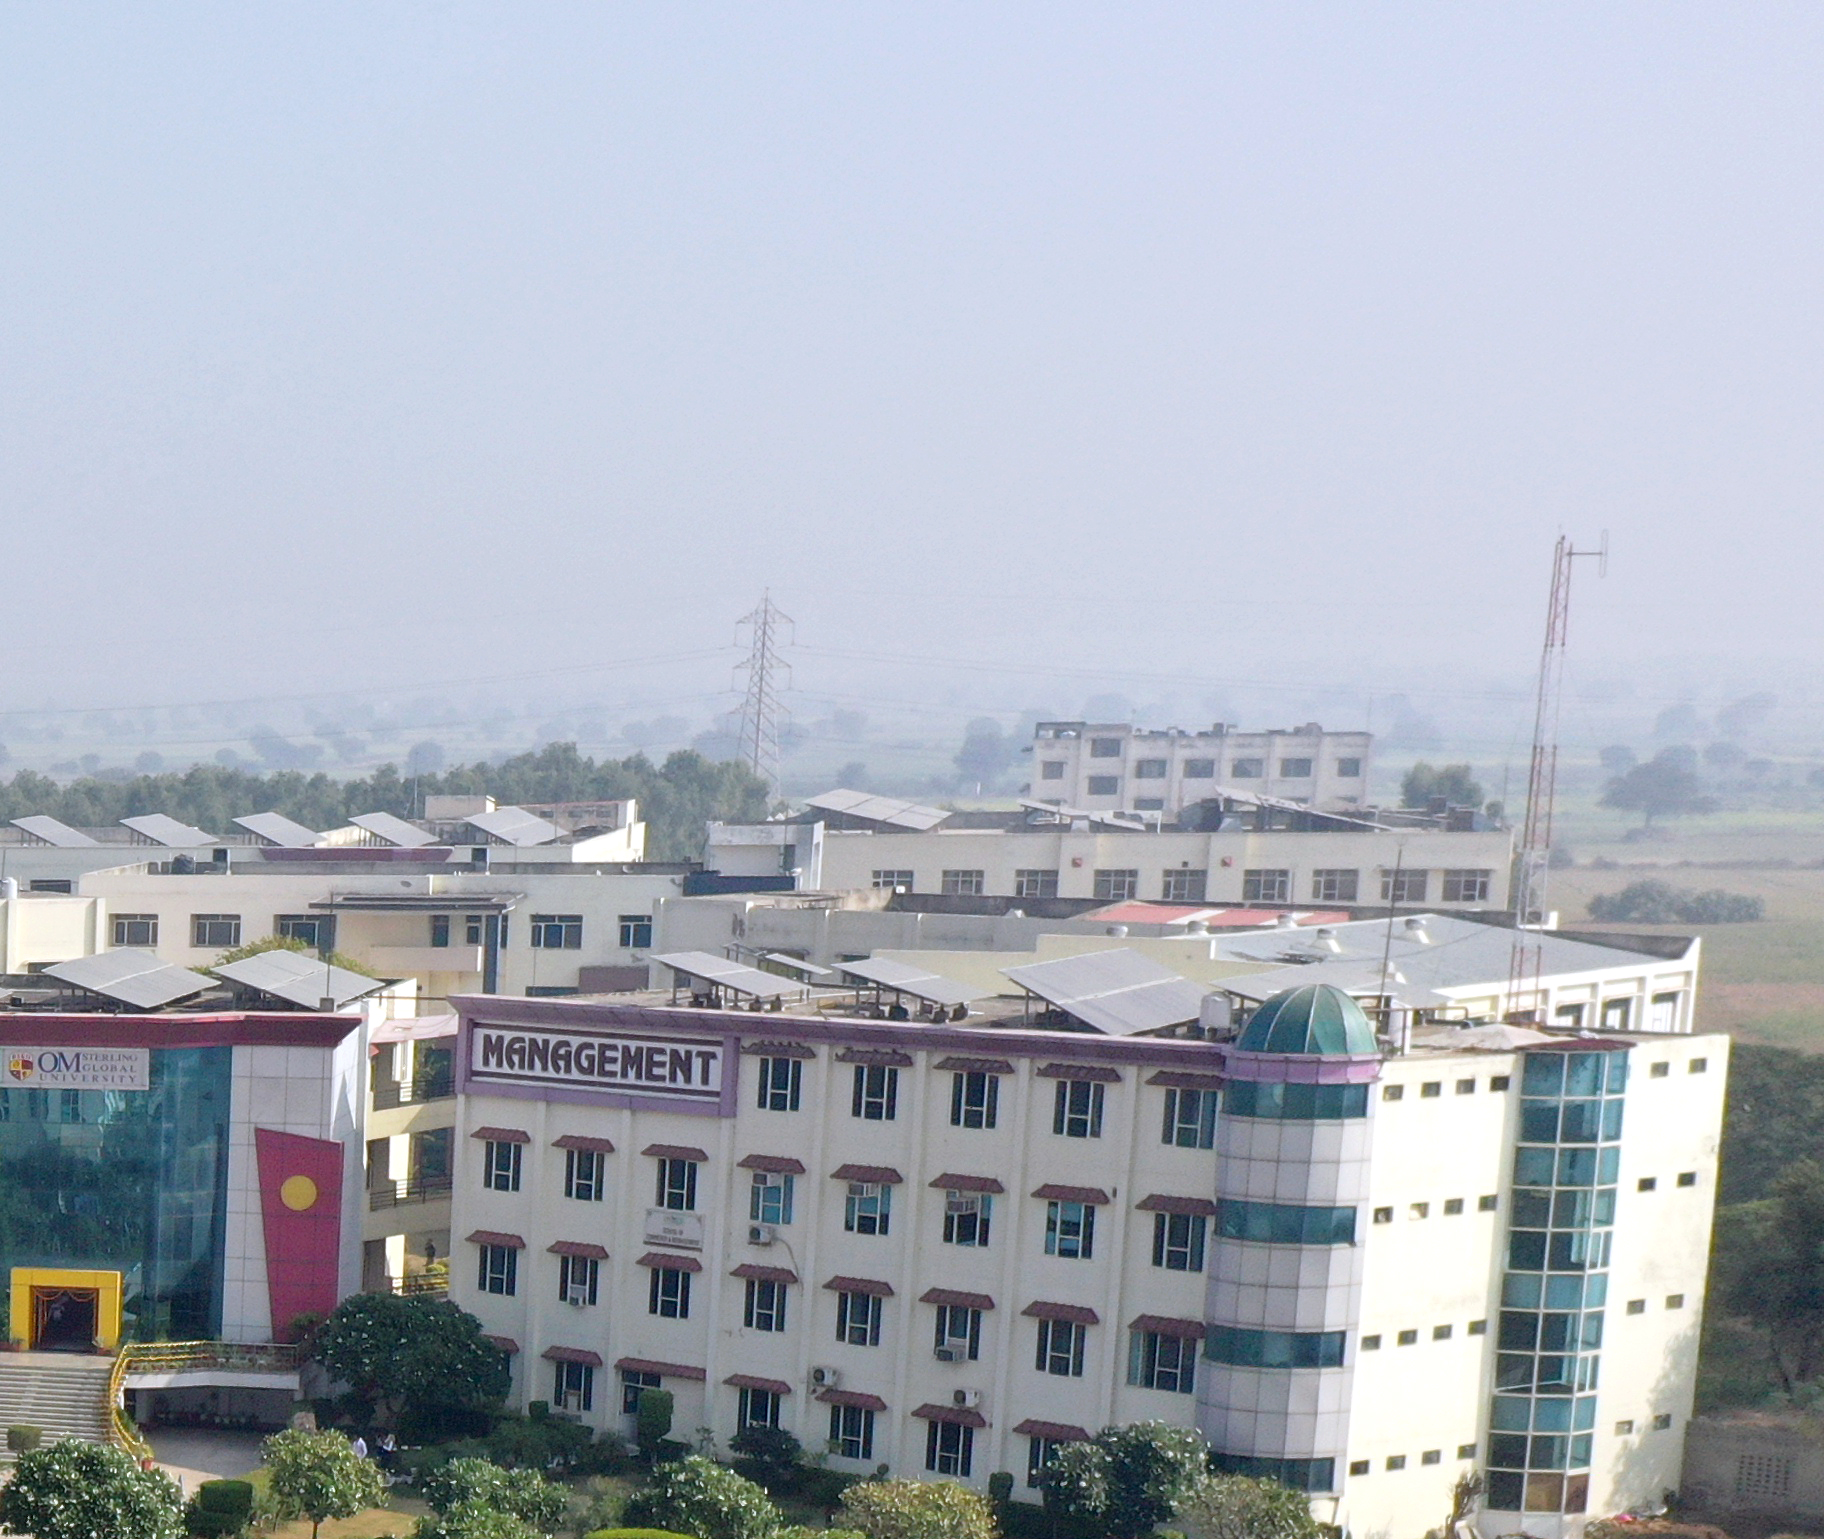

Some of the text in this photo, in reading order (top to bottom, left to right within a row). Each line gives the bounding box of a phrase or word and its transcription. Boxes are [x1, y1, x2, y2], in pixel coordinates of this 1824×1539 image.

[38, 1051, 82, 1073] OM
[82, 1053, 138, 1062] STERLING
[482, 1033, 718, 1086] MANAGEMENT
[82, 1063, 137, 1073] GLOBAL
[39, 1073, 137, 1083] UNIVERSITY
